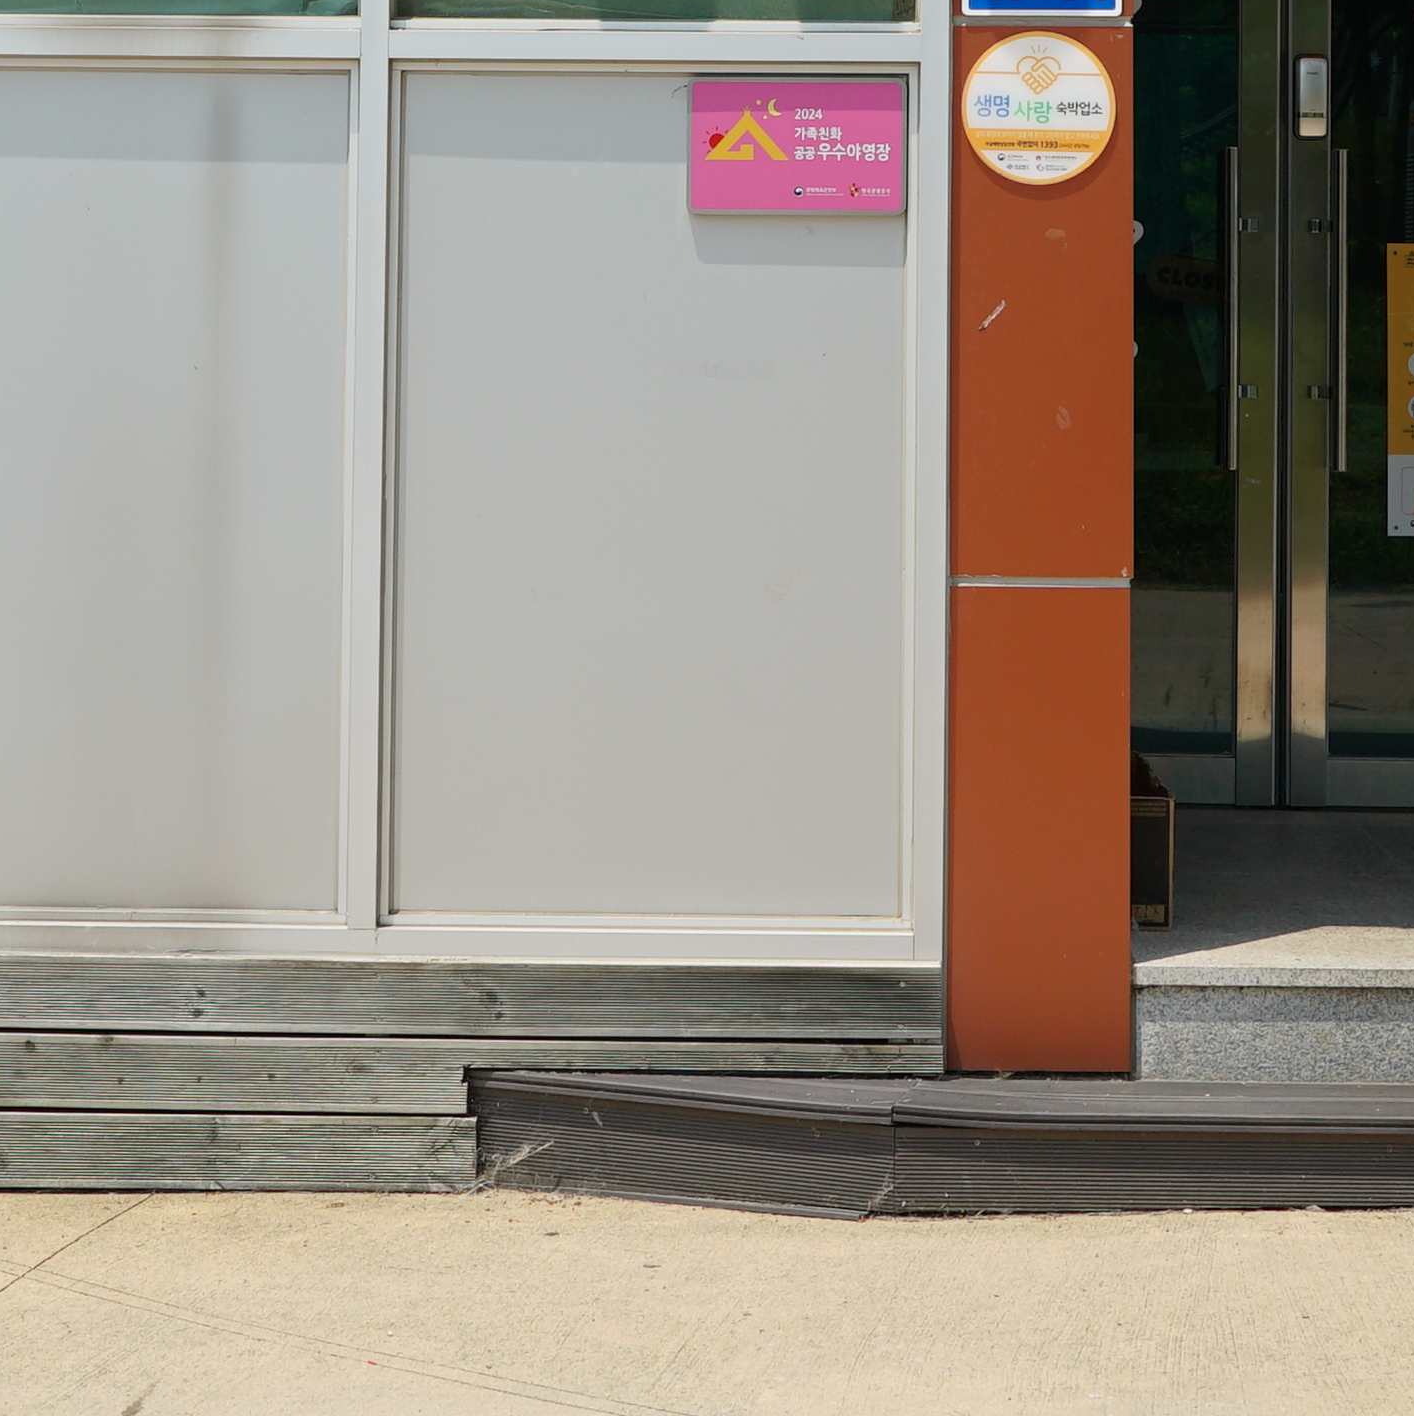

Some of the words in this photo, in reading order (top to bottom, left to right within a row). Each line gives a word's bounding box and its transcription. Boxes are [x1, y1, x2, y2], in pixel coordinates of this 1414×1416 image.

[793, 108, 823, 120] 2024
[973, 94, 1010, 118] 생명
[1014, 100, 1053, 124] 사랑
[1055, 101, 1103, 117] 숙박업소
[793, 126, 843, 141] 가족친화
[1040, 141, 1059, 149] 1393
